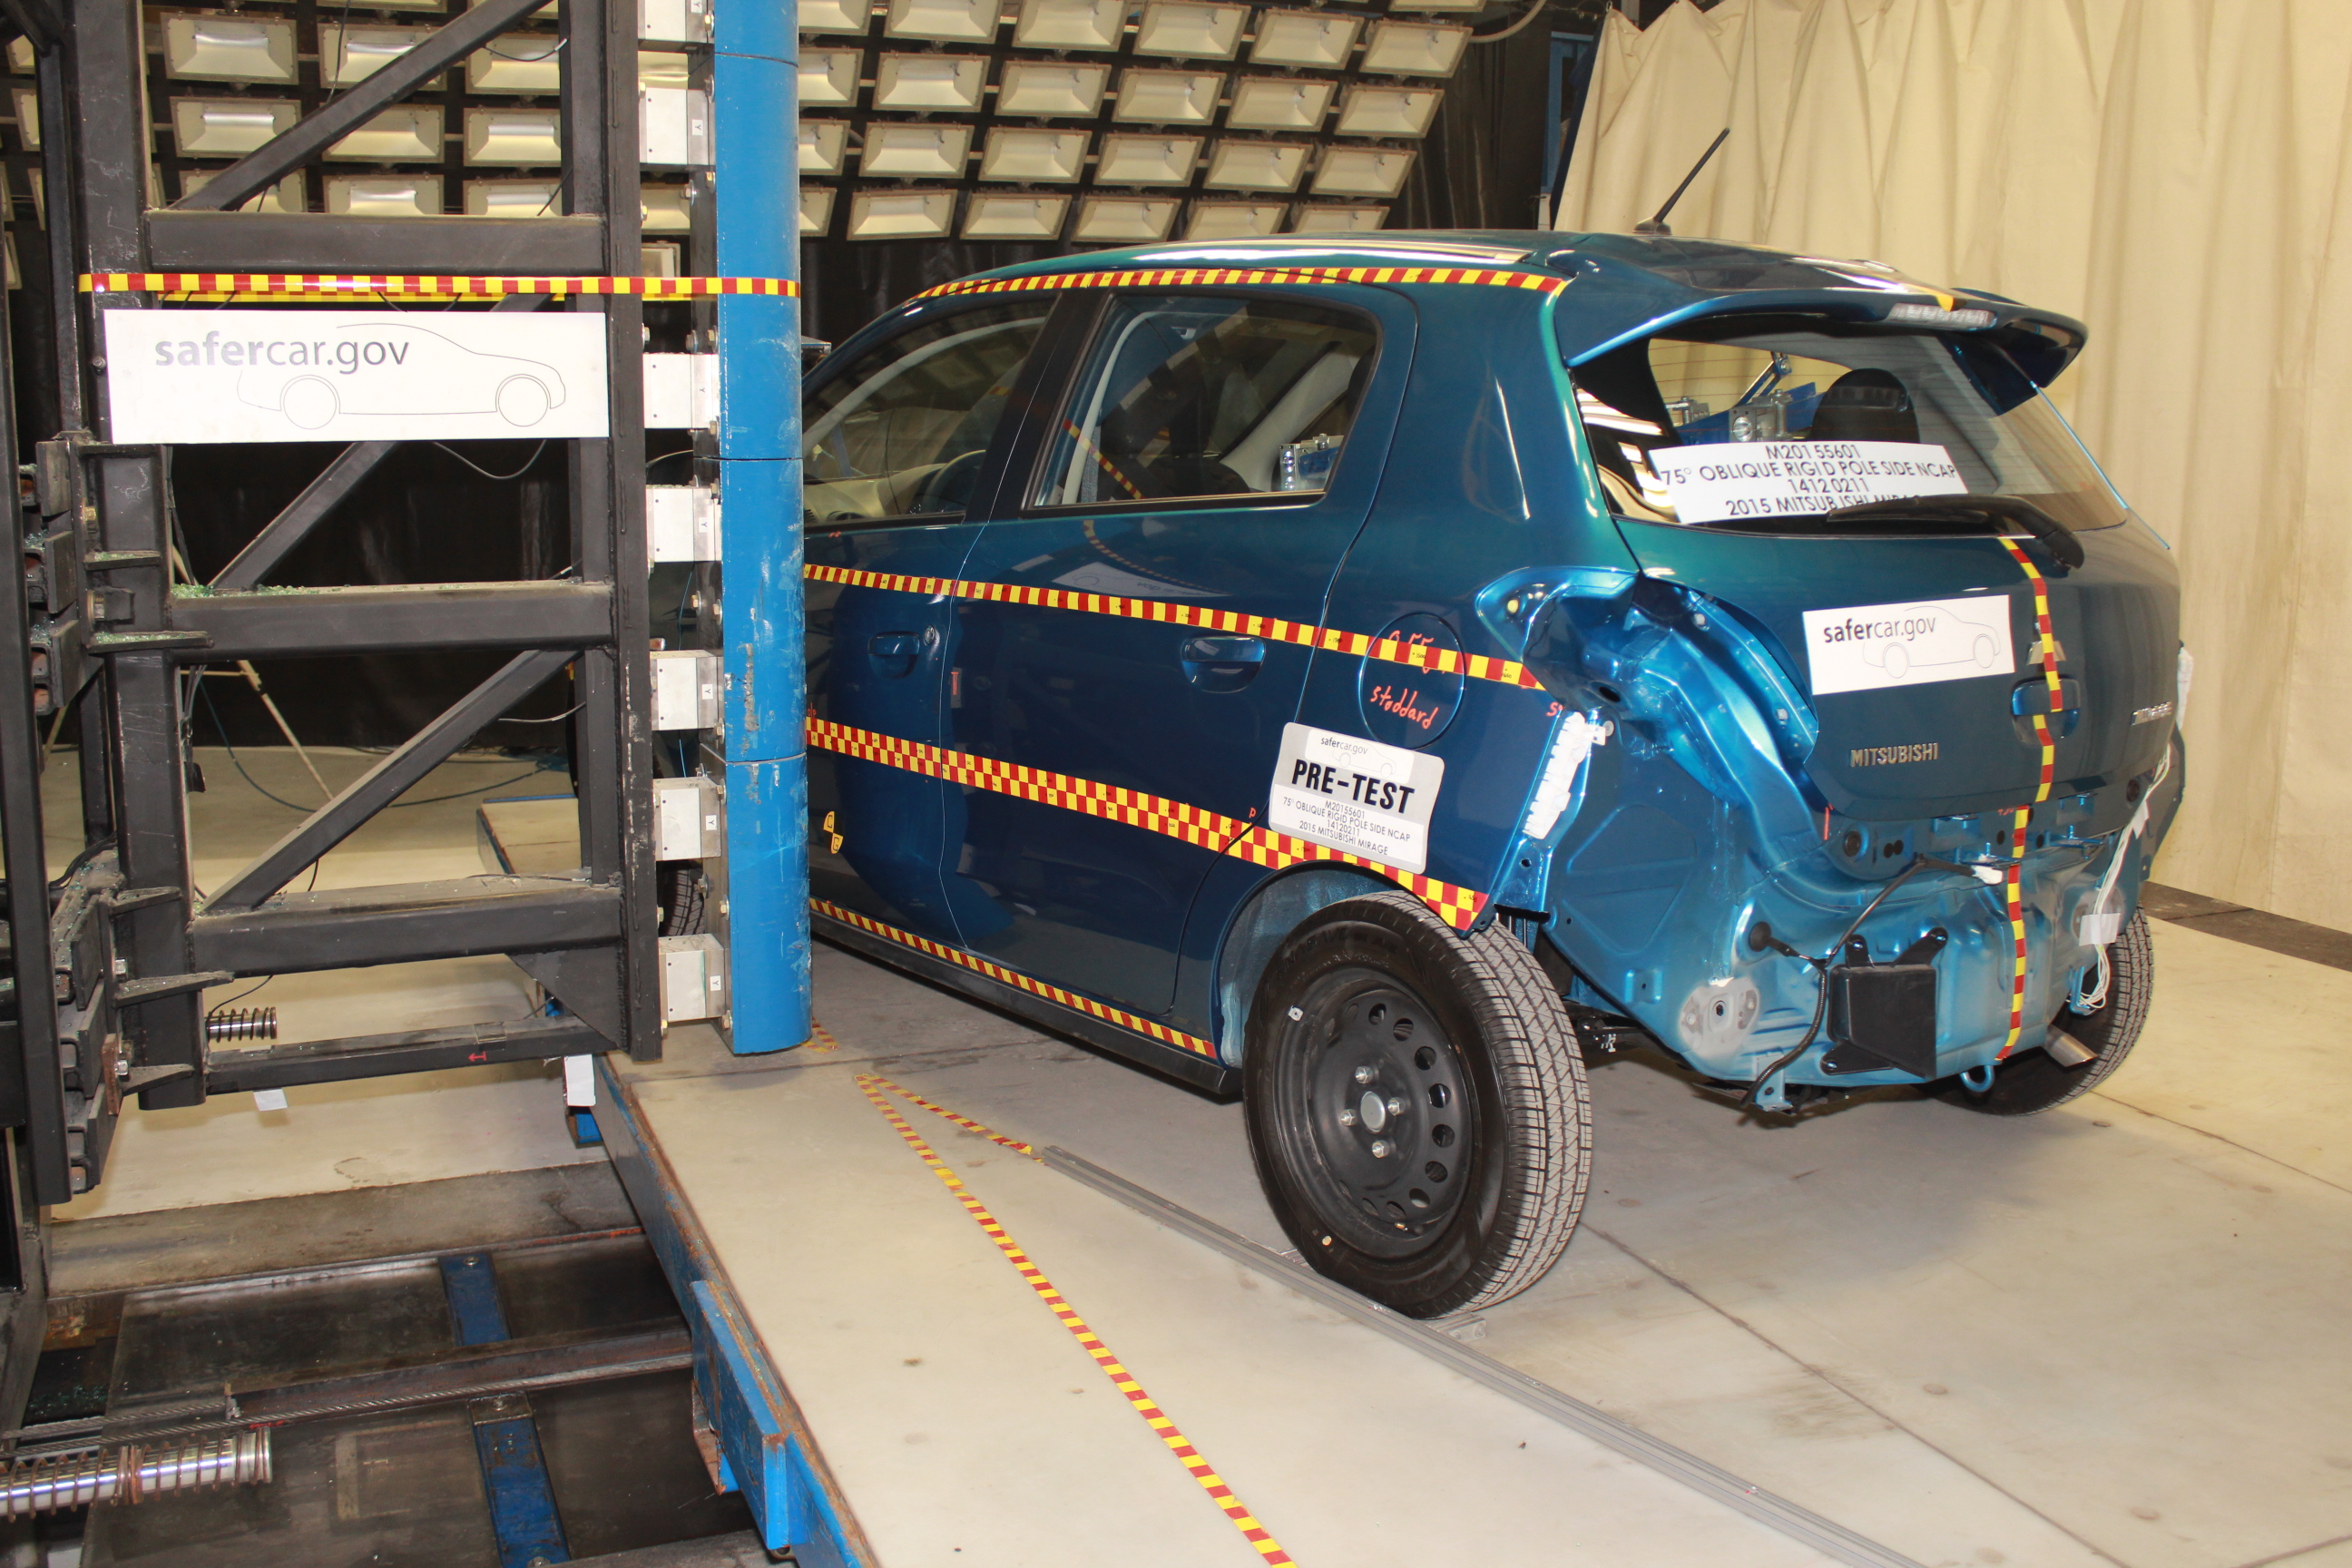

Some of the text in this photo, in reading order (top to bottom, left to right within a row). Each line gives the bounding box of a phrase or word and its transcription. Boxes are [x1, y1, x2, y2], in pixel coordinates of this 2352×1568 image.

[154, 330, 409, 375] safercar.gov
[1699, 462, 1782, 482] OBLIQUE
[1783, 461, 1836, 477] RIGID
[1838, 460, 1880, 475] POLE
[1880, 461, 1916, 476] SIDE
[1915, 462, 1956, 478] NCAP
[1725, 497, 1772, 516] 2015
[1823, 617, 1936, 643] safercar.gov
[1320, 736, 1368, 755] safercar.gov
[1850, 741, 1939, 768] MITSUBISHI
[1291, 759, 1416, 814] PRE-TEST
[1296, 800, 1326, 818] OBLIQUE
[1327, 810, 1348, 824] RIGID
[1349, 817, 1368, 830] POLE
[1369, 822, 1387, 836] SIDE
[1387, 828, 1411, 842] NCAP
[1325, 799, 1365, 819] M20155601
[1299, 819, 1388, 856] 2015 MITSUBISHI MIRAGE
[1327, 818, 1360, 838] 14120211
